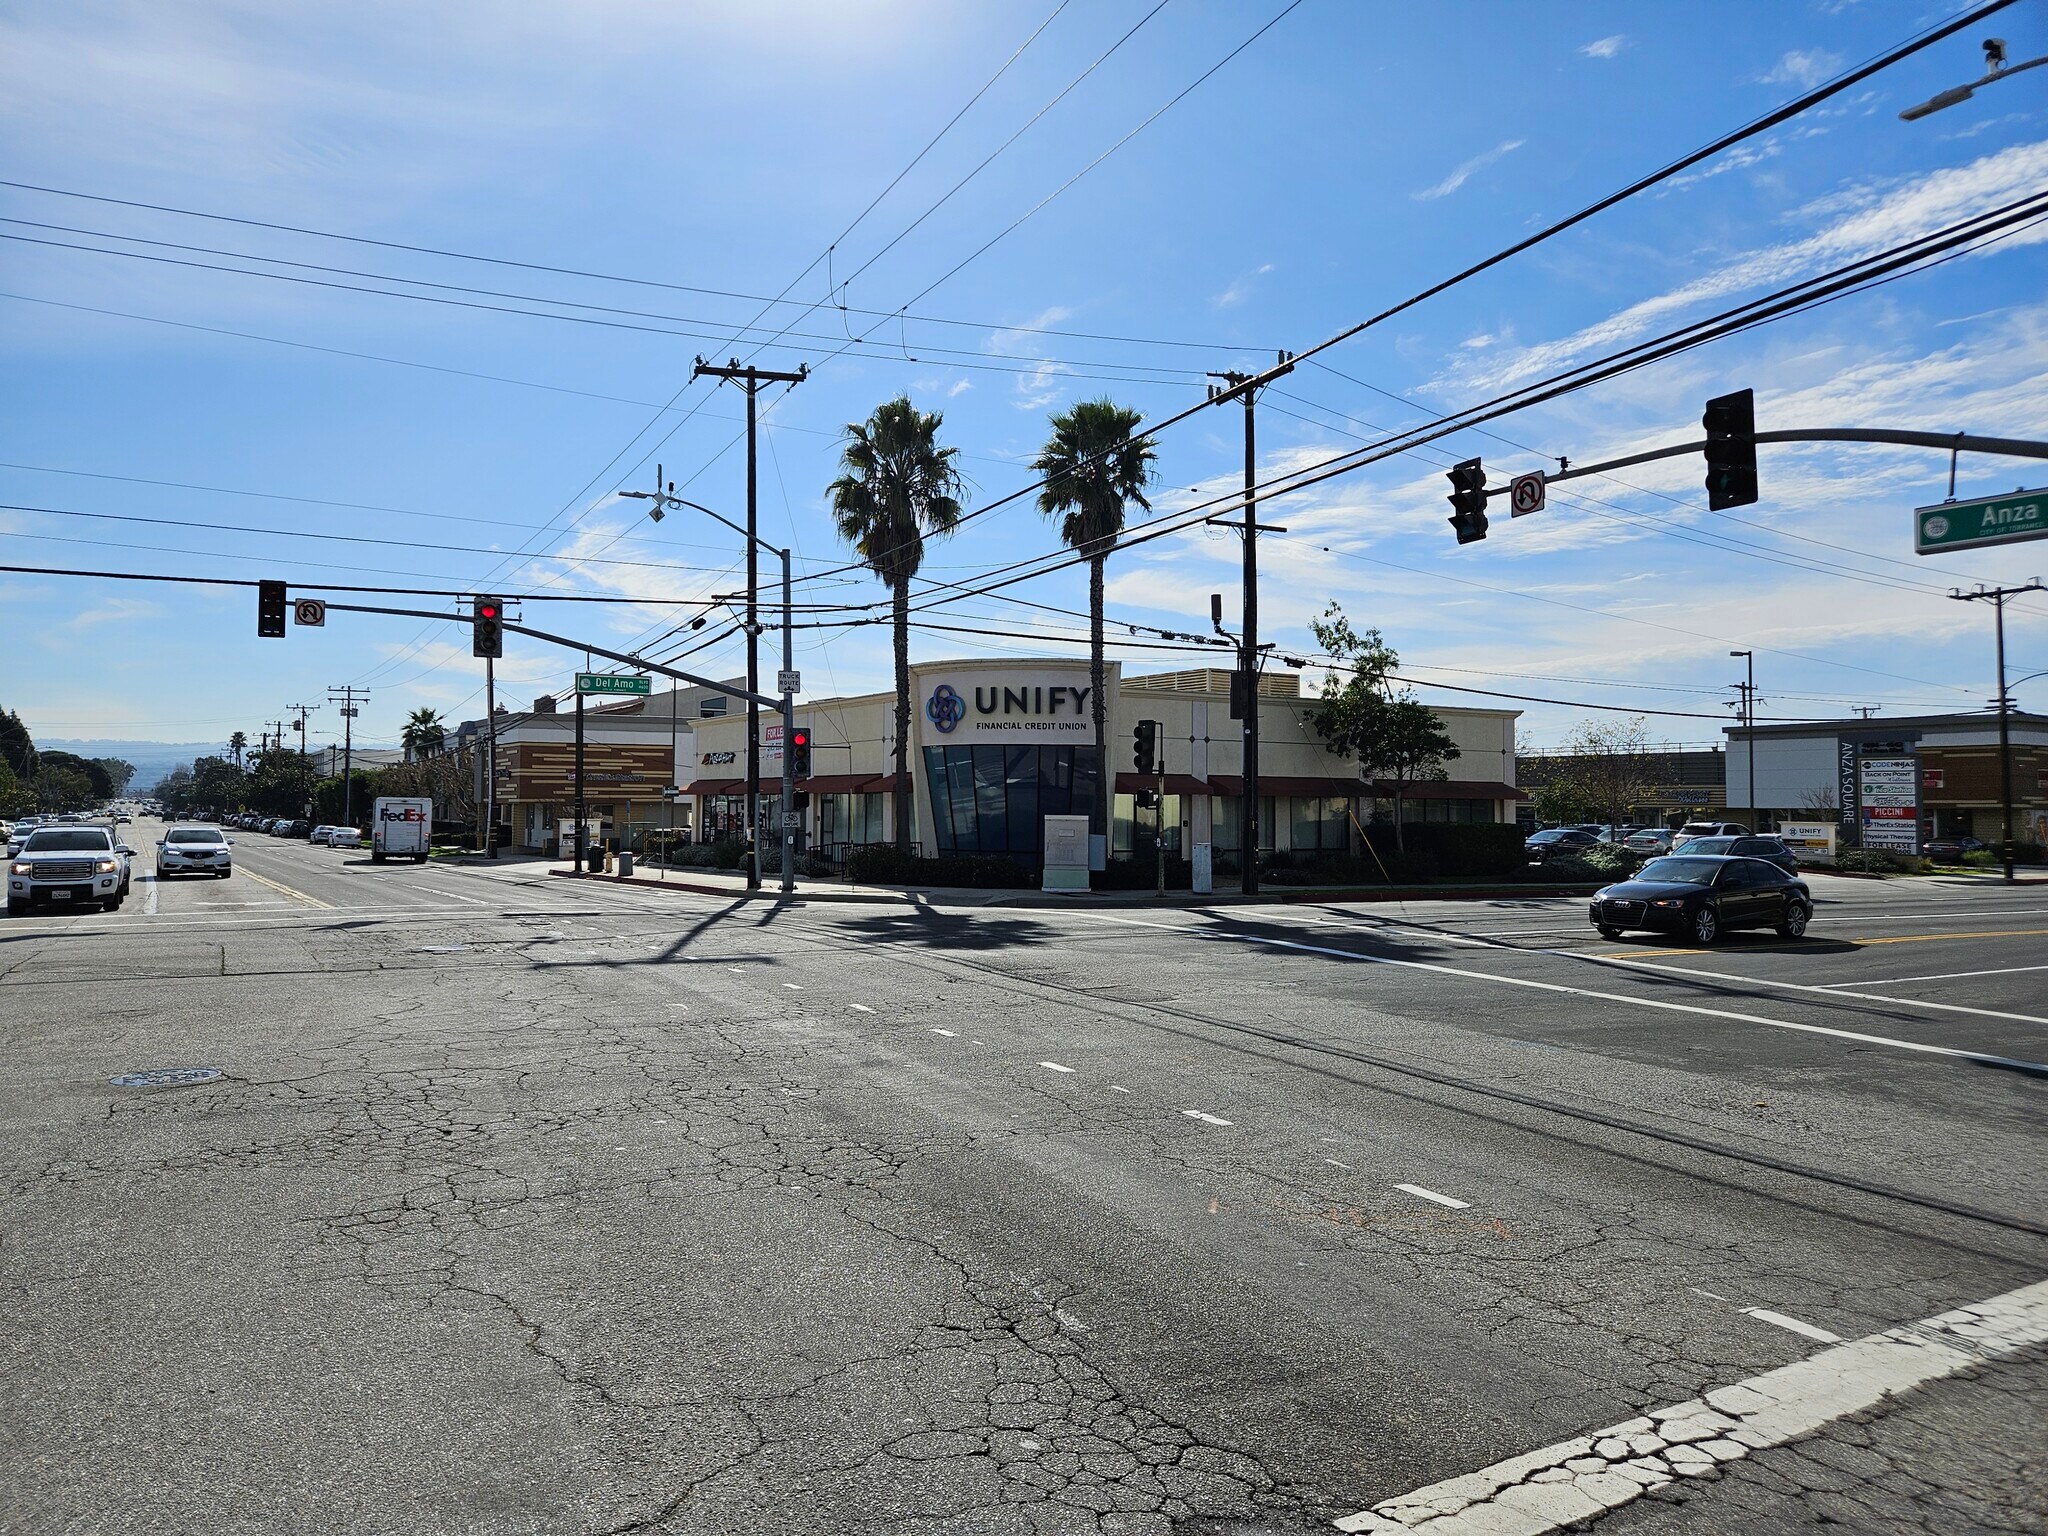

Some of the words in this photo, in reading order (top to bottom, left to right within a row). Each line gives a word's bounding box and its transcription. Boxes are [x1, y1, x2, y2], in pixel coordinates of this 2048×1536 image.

[1981, 504, 2040, 527] Anza
[1979, 528, 1996, 536] CITY
[1996, 526, 2008, 534] OF
[2008, 521, 2044, 532] TORRANCE
[595, 678, 611, 687] Del
[614, 679, 634, 688] Amo
[975, 686, 1092, 715] UNIFY
[767, 727, 776, 739] FOR
[976, 722, 1022, 730] FINANCIAL
[1025, 722, 1056, 730] CREDIT
[1841, 742, 1853, 775] ANZA
[1842, 777, 1855, 823] SQUARE
[380, 808, 428, 821] FedEx
[1874, 807, 1903, 816] PICCINI
